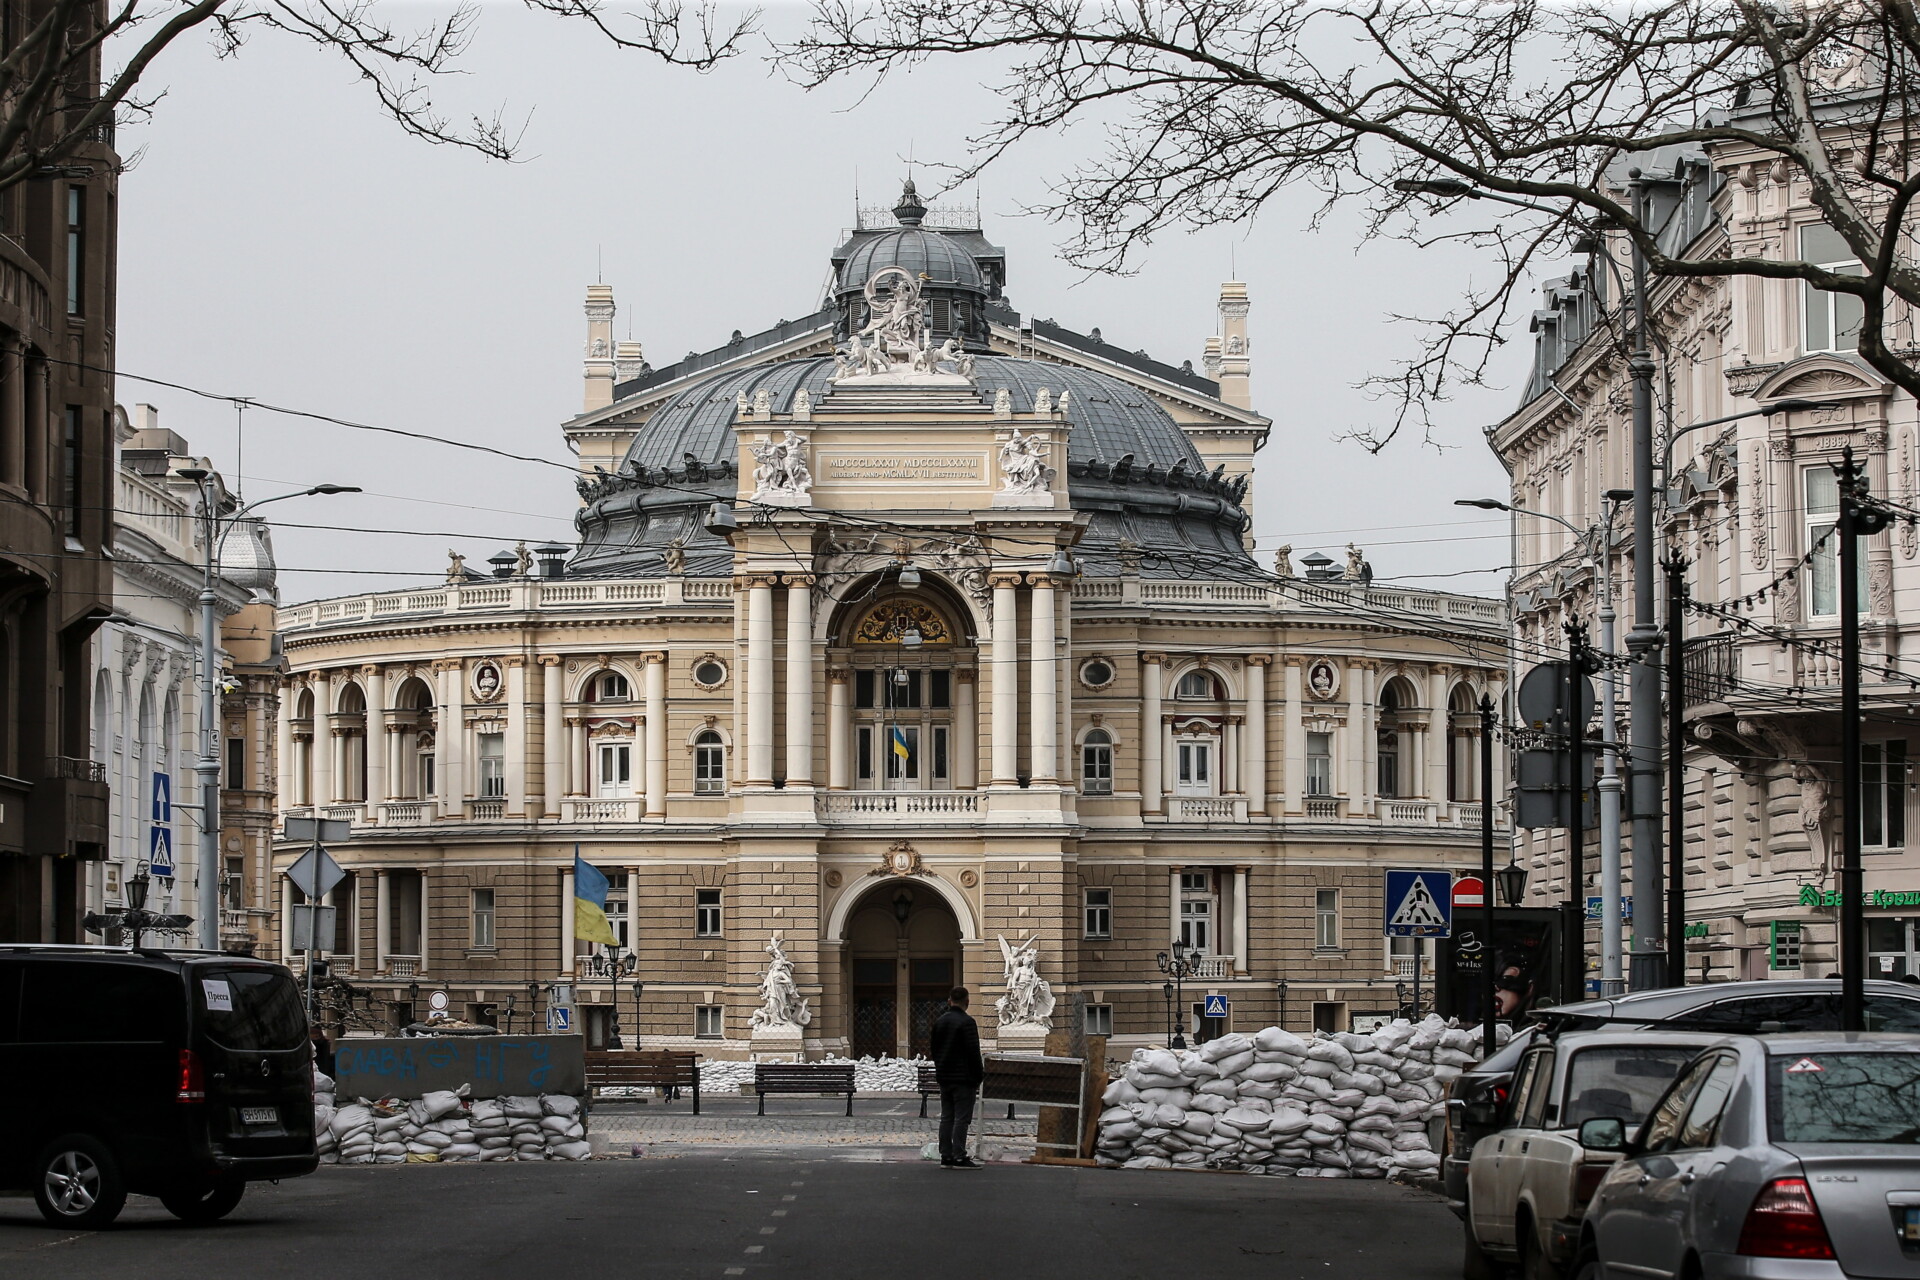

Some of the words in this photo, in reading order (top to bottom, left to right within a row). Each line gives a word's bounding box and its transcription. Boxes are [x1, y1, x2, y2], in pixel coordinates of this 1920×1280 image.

[1819, 436, 1843, 448] 1886
[830, 459, 900, 468] MDCCCLXXXIV
[904, 458, 978, 468] MDCCCLXXXVII
[207, 991, 229, 1002] Пресса
[335, 1047, 416, 1080] СЛАВА
